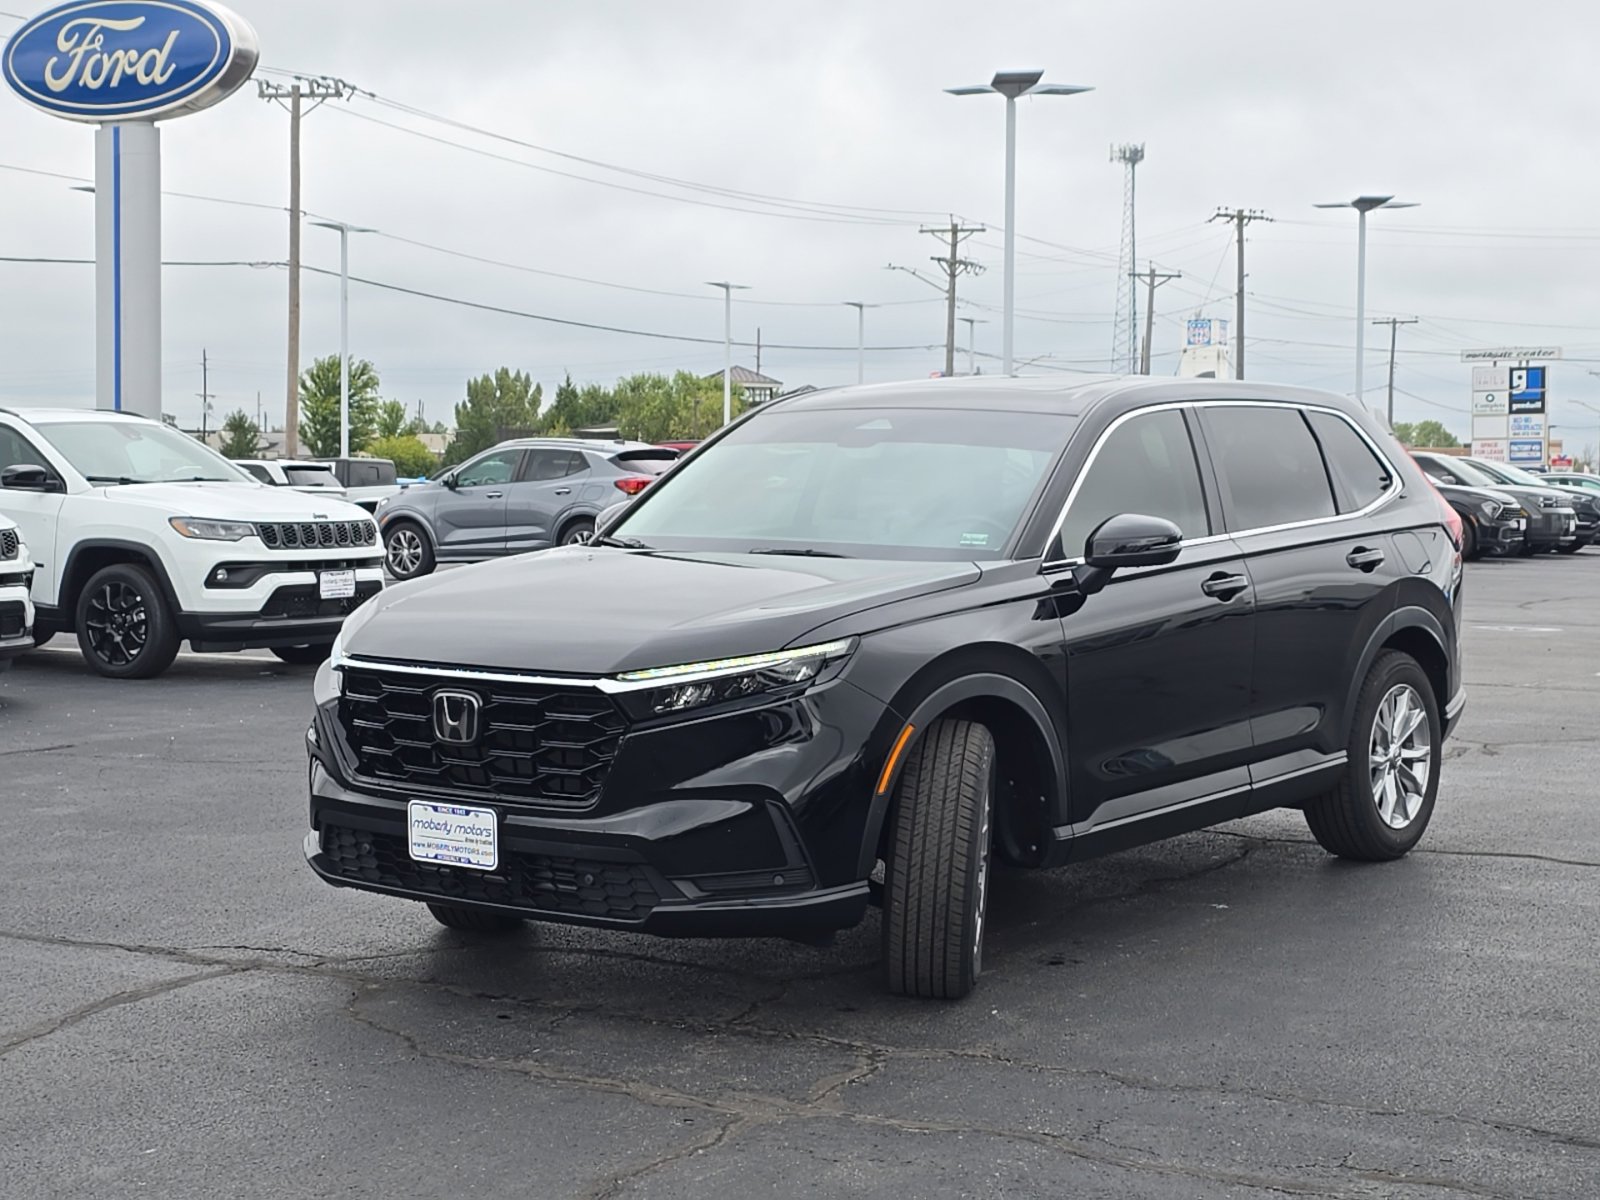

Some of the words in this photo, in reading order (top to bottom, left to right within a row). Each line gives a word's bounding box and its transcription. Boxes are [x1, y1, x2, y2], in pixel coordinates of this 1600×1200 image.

[45, 16, 180, 92] Ford
[1516, 349, 1555, 358] center
[413, 818, 452, 835] moberly
[454, 824, 492, 838] motors
